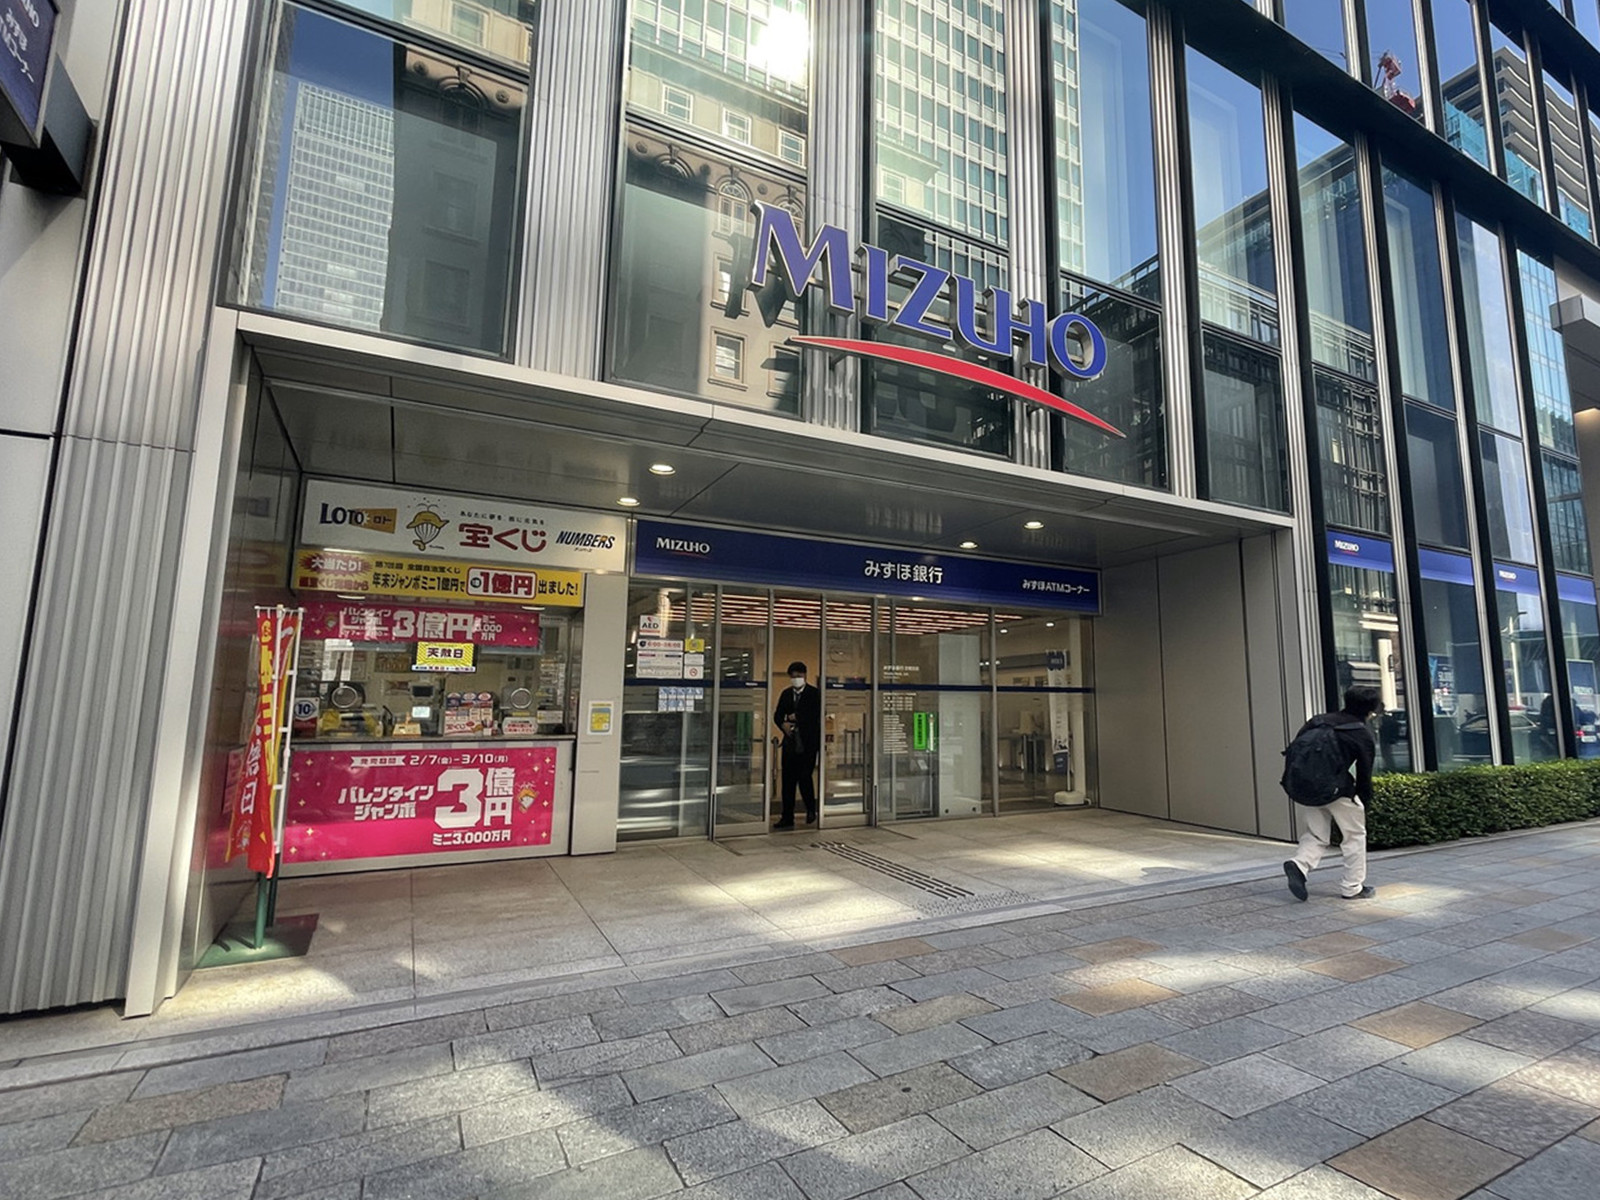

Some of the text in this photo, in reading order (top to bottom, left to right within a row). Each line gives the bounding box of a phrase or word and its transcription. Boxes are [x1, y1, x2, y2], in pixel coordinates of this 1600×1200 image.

[747, 199, 1108, 381] MIZUHO
[320, 502, 365, 525] LOTO
[458, 523, 547, 553] 宝くじ
[555, 530, 616, 550] NUMBERS
[656, 537, 711, 554] MIZUHO
[864, 560, 944, 584] みずほ銀行
[1022, 579, 1091, 595] みずほATMコーナー
[391, 610, 475, 640] 3億円
[297, 700, 311, 714] 10
[337, 785, 435, 804] バレンタイン
[354, 801, 417, 821] ジャンボ
